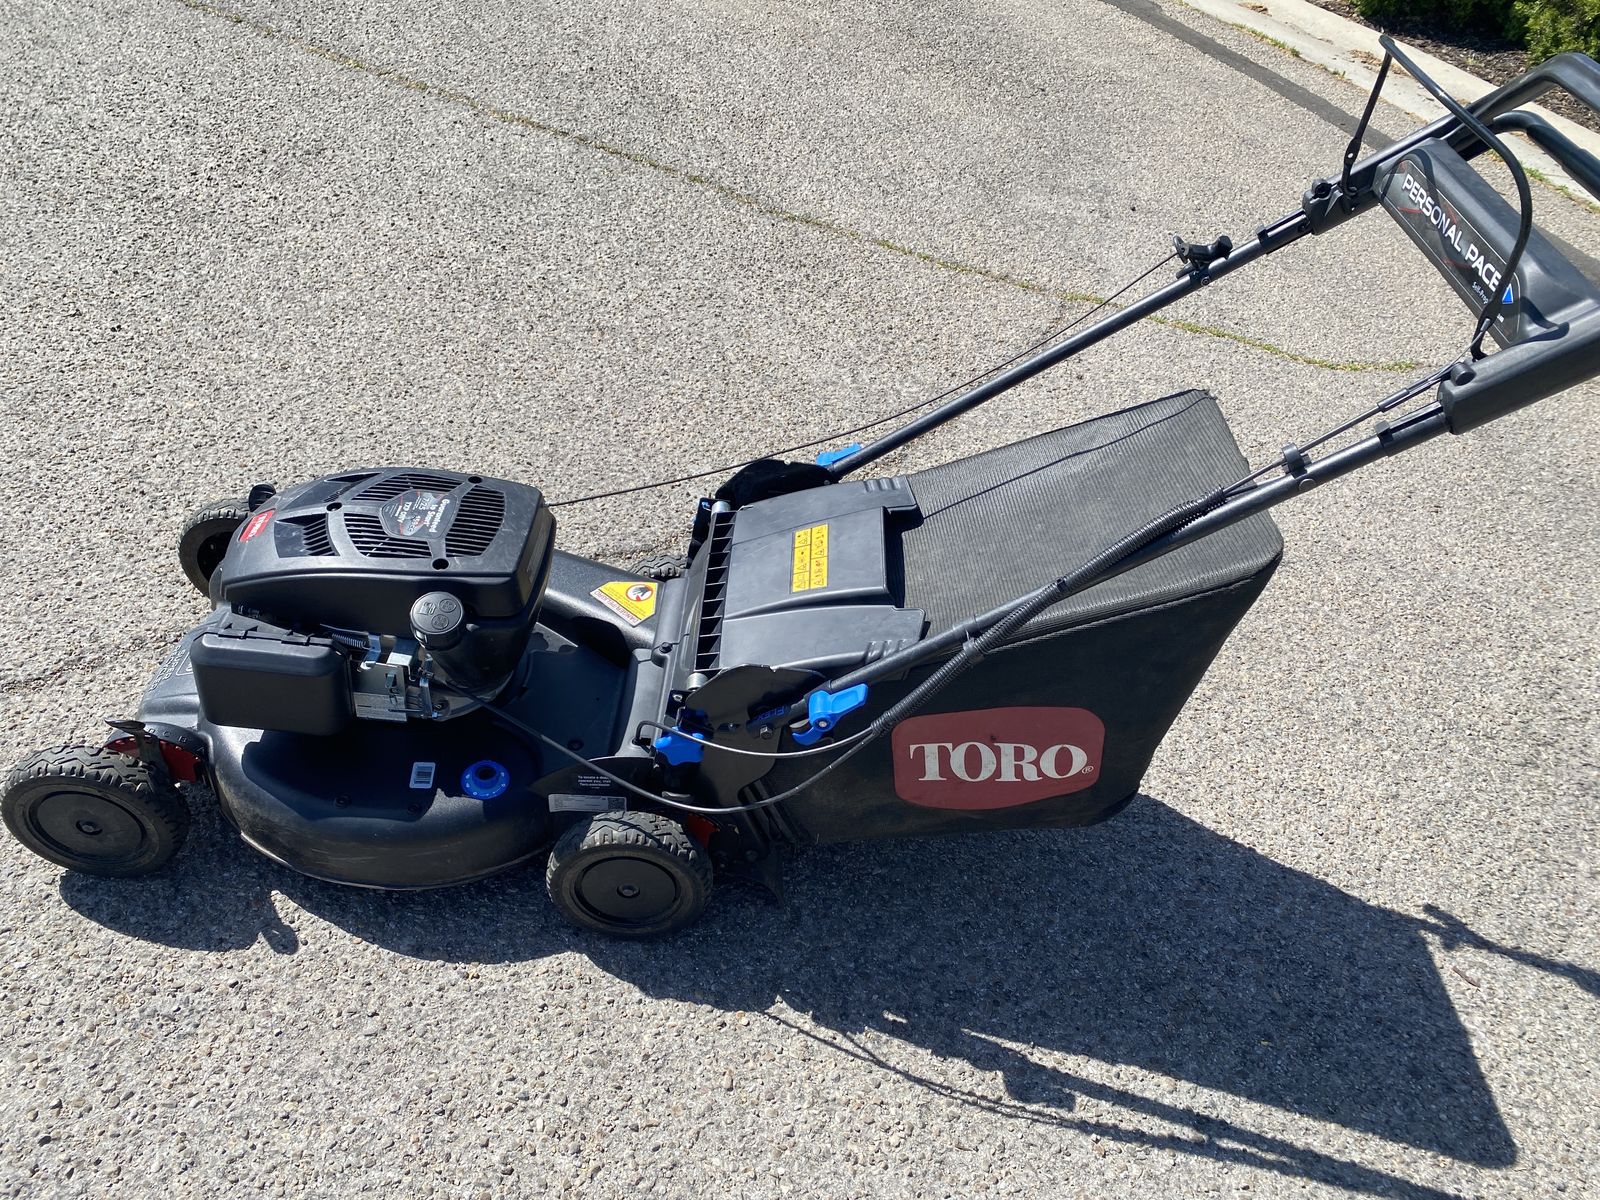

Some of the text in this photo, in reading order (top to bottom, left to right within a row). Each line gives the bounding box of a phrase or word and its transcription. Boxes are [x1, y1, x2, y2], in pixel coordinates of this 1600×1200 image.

[1402, 174, 1503, 293] PERSONAL PACE
[429, 499, 450, 532] Guaranteed
[909, 741, 1088, 783] TORO
